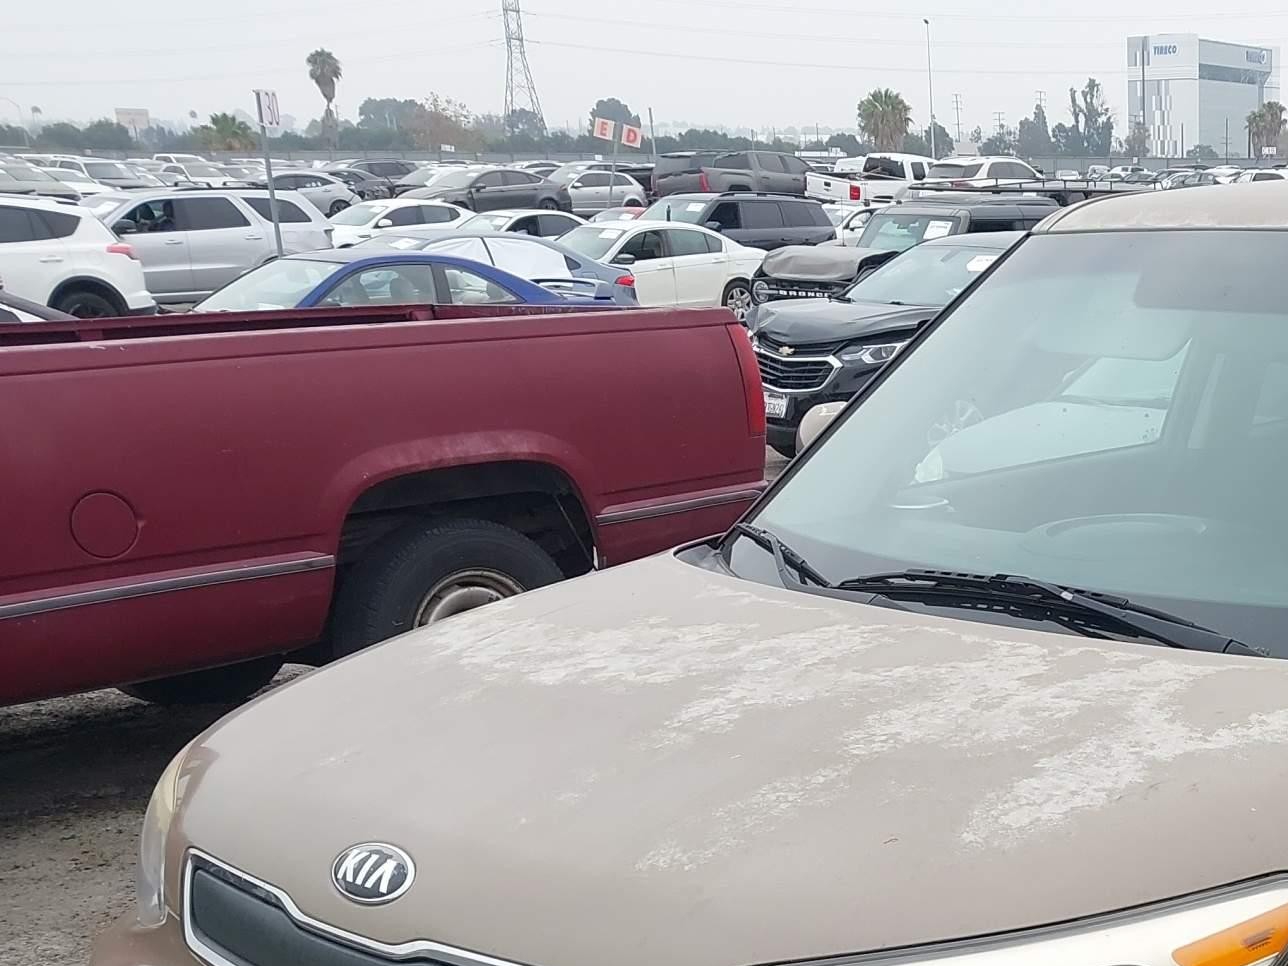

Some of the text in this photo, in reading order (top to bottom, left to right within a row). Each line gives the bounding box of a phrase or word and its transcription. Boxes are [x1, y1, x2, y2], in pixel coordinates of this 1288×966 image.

[599, 121, 609, 137] E
[626, 128, 637, 143] D
[336, 848, 398, 894] KIA
